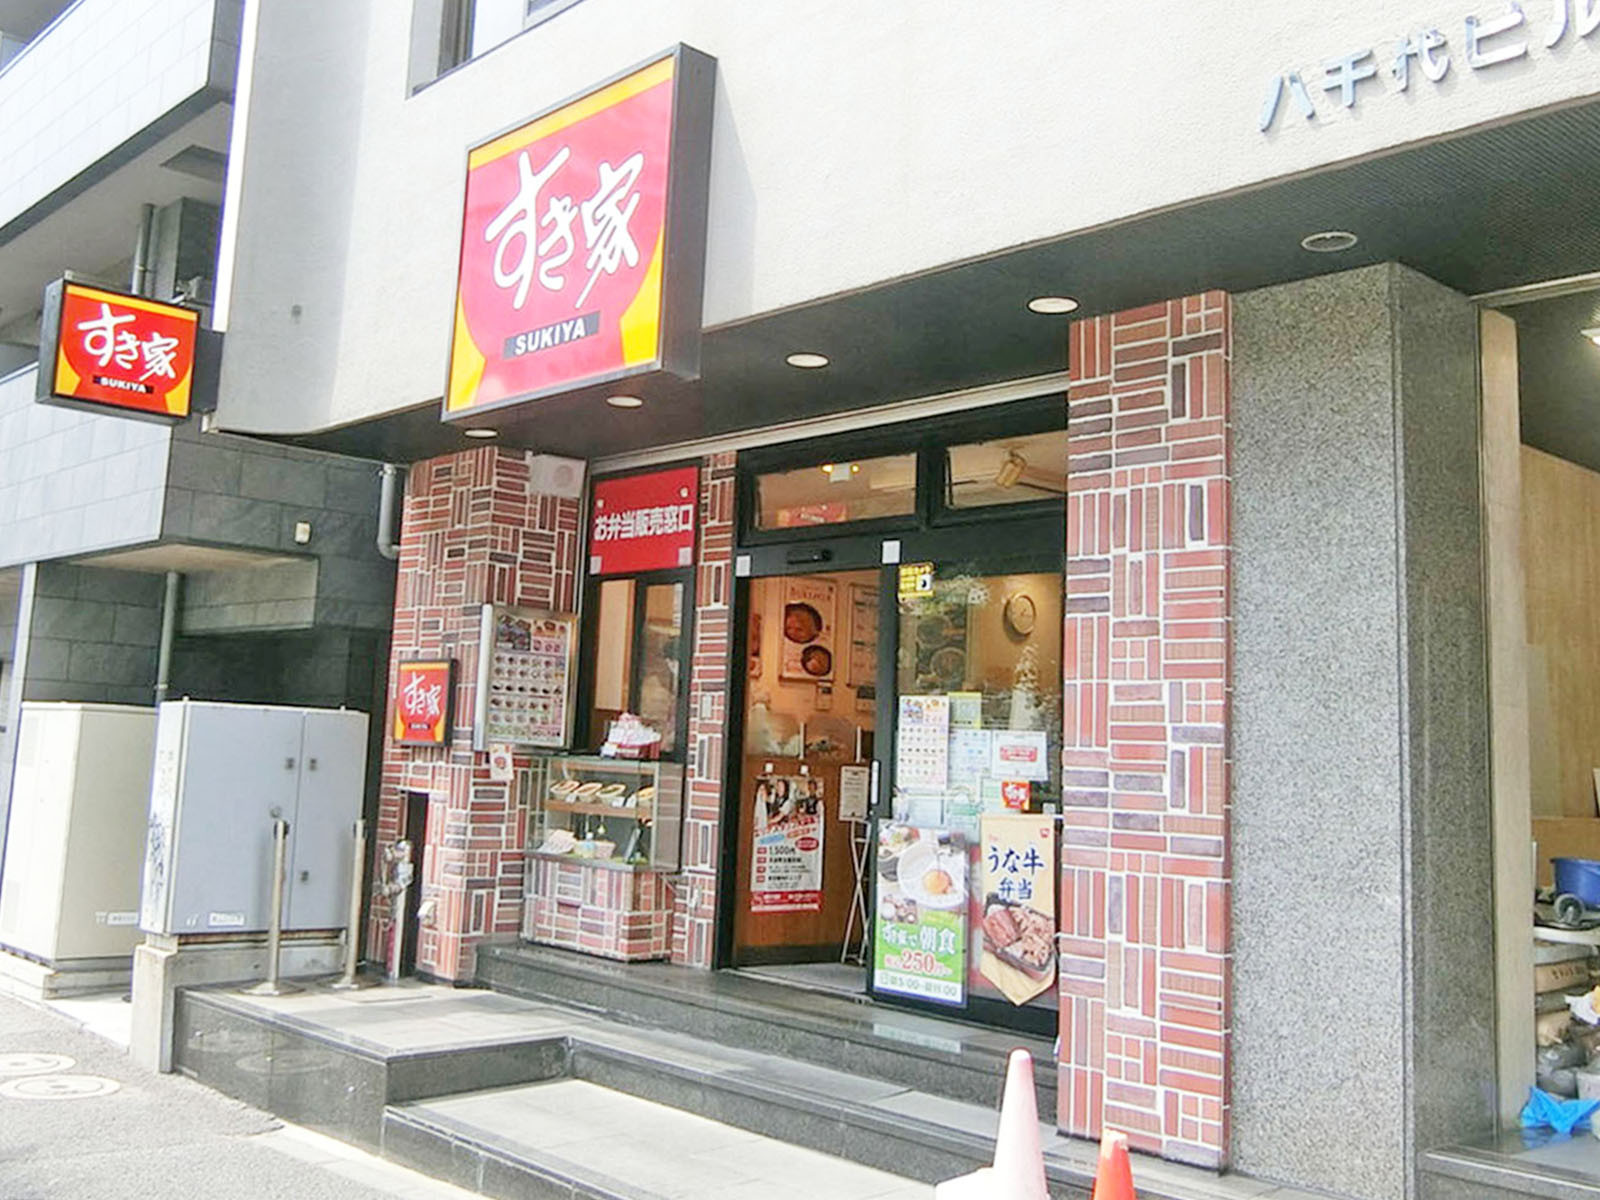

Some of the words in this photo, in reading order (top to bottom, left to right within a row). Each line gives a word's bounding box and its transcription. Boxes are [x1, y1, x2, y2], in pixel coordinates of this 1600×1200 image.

[484, 145, 645, 310] すき家
[77, 302, 180, 382] すき家
[515, 317, 586, 356] SUKIYA
[100, 376, 147, 394] SUKIYA
[594, 504, 694, 541] お弁当販売窓口
[987, 845, 1044, 875] うな牛
[998, 877, 1033, 900] 弁当
